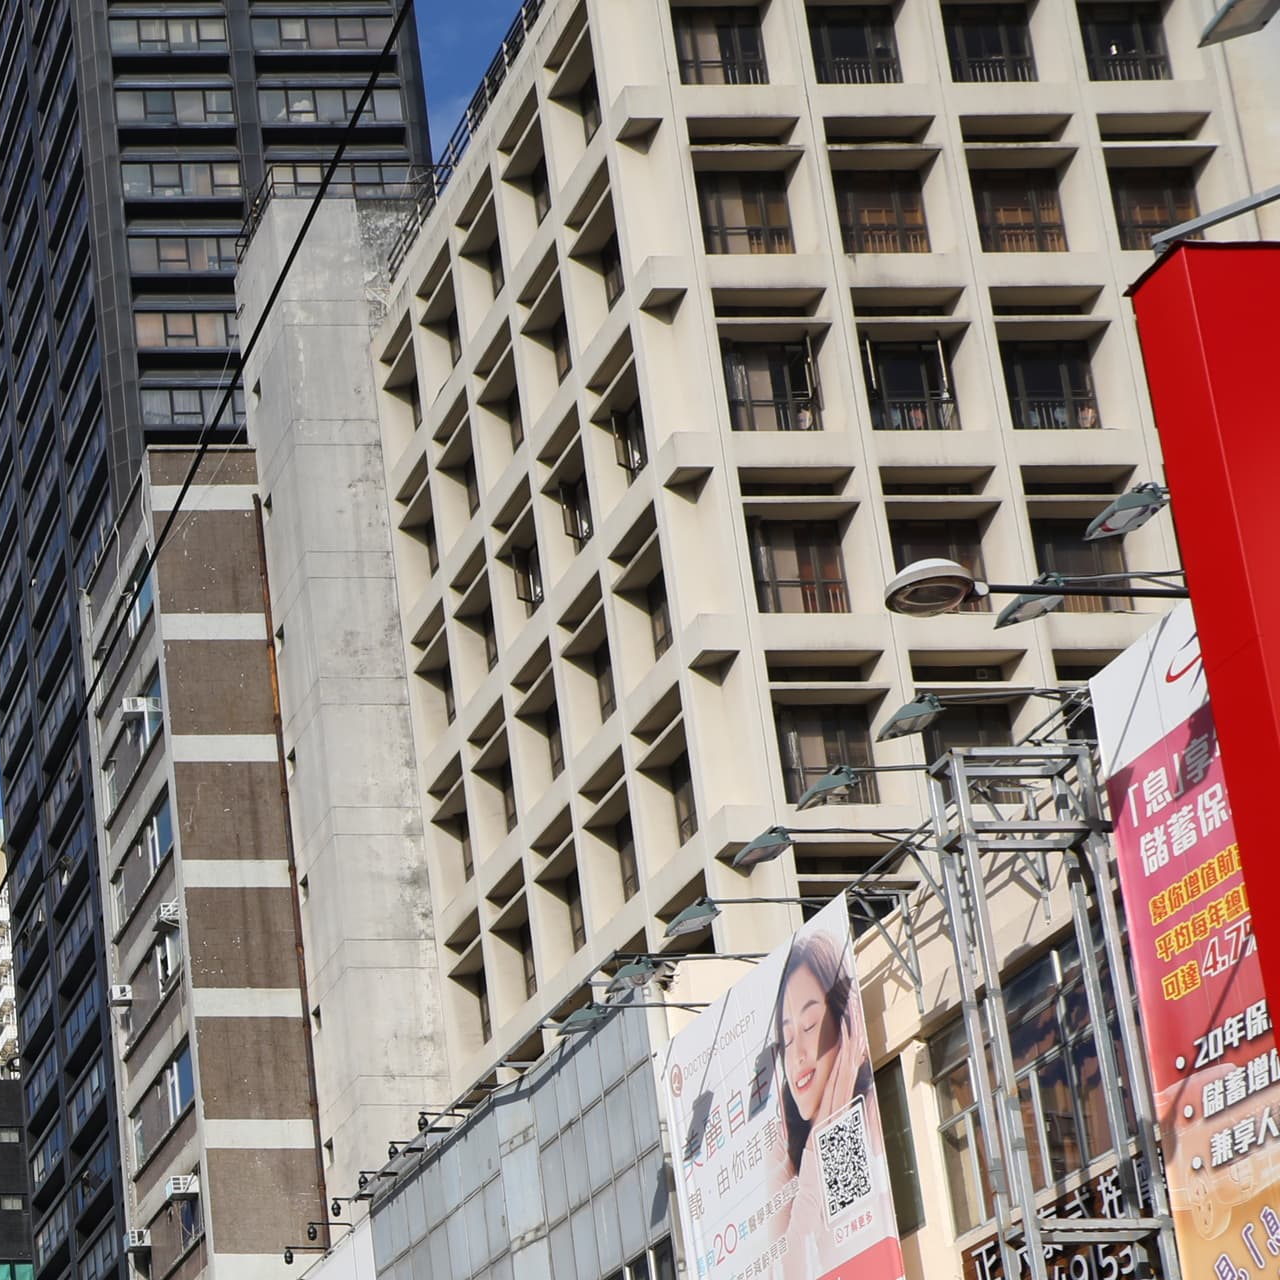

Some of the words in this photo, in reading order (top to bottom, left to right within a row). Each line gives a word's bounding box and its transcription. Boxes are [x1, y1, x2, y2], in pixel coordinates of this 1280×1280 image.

[1127, 734, 1220, 828] 「息」享
[1140, 781, 1232, 876] 儲蓄保
[1155, 883, 1249, 961] 平均每年總
[719, 1011, 757, 1050] CONCEPT
[1194, 999, 1272, 1068] 20年保
